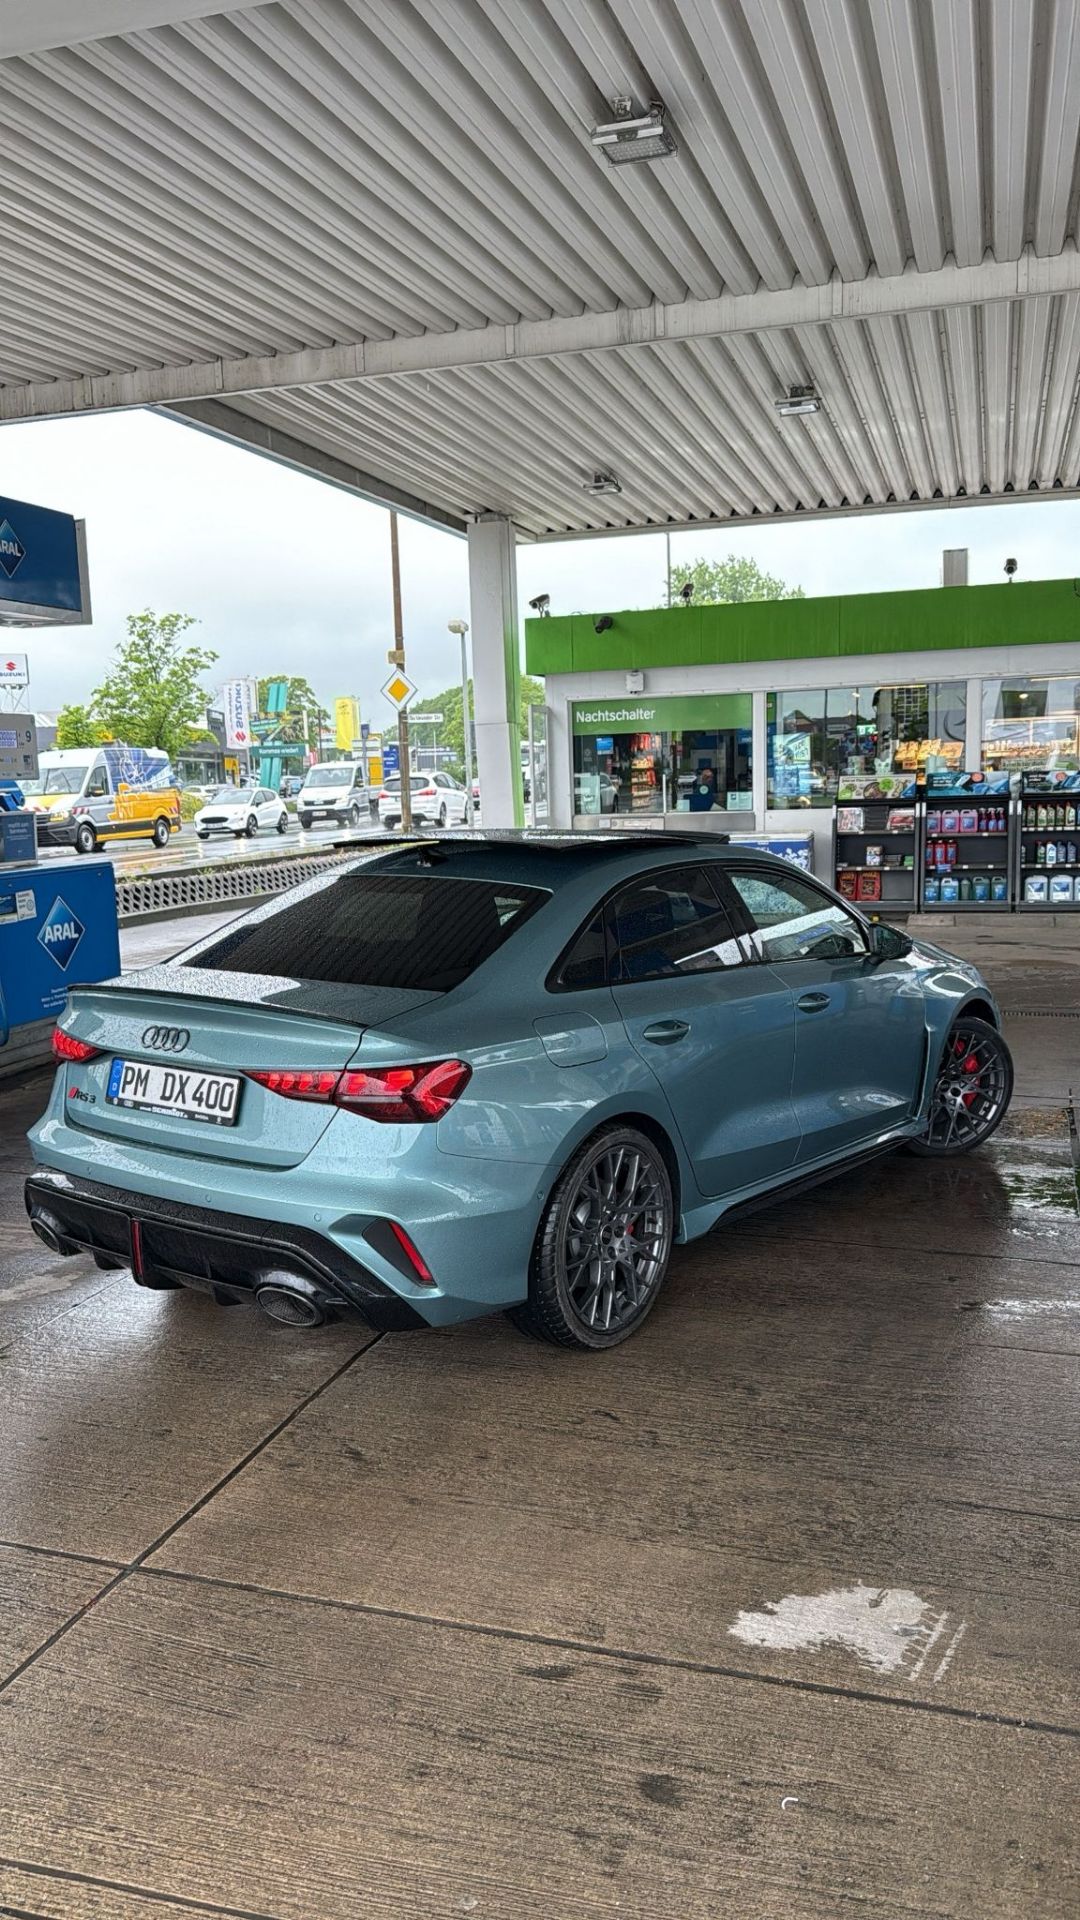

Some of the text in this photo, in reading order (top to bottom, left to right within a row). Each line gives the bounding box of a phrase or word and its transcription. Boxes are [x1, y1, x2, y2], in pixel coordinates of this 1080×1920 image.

[576, 708, 656, 723] Nachtschalter
[25, 730, 32, 743] 9
[44, 921, 79, 944] ARAL
[112, 1082, 118, 1091] D
[121, 1066, 235, 1112] PM DX 400
